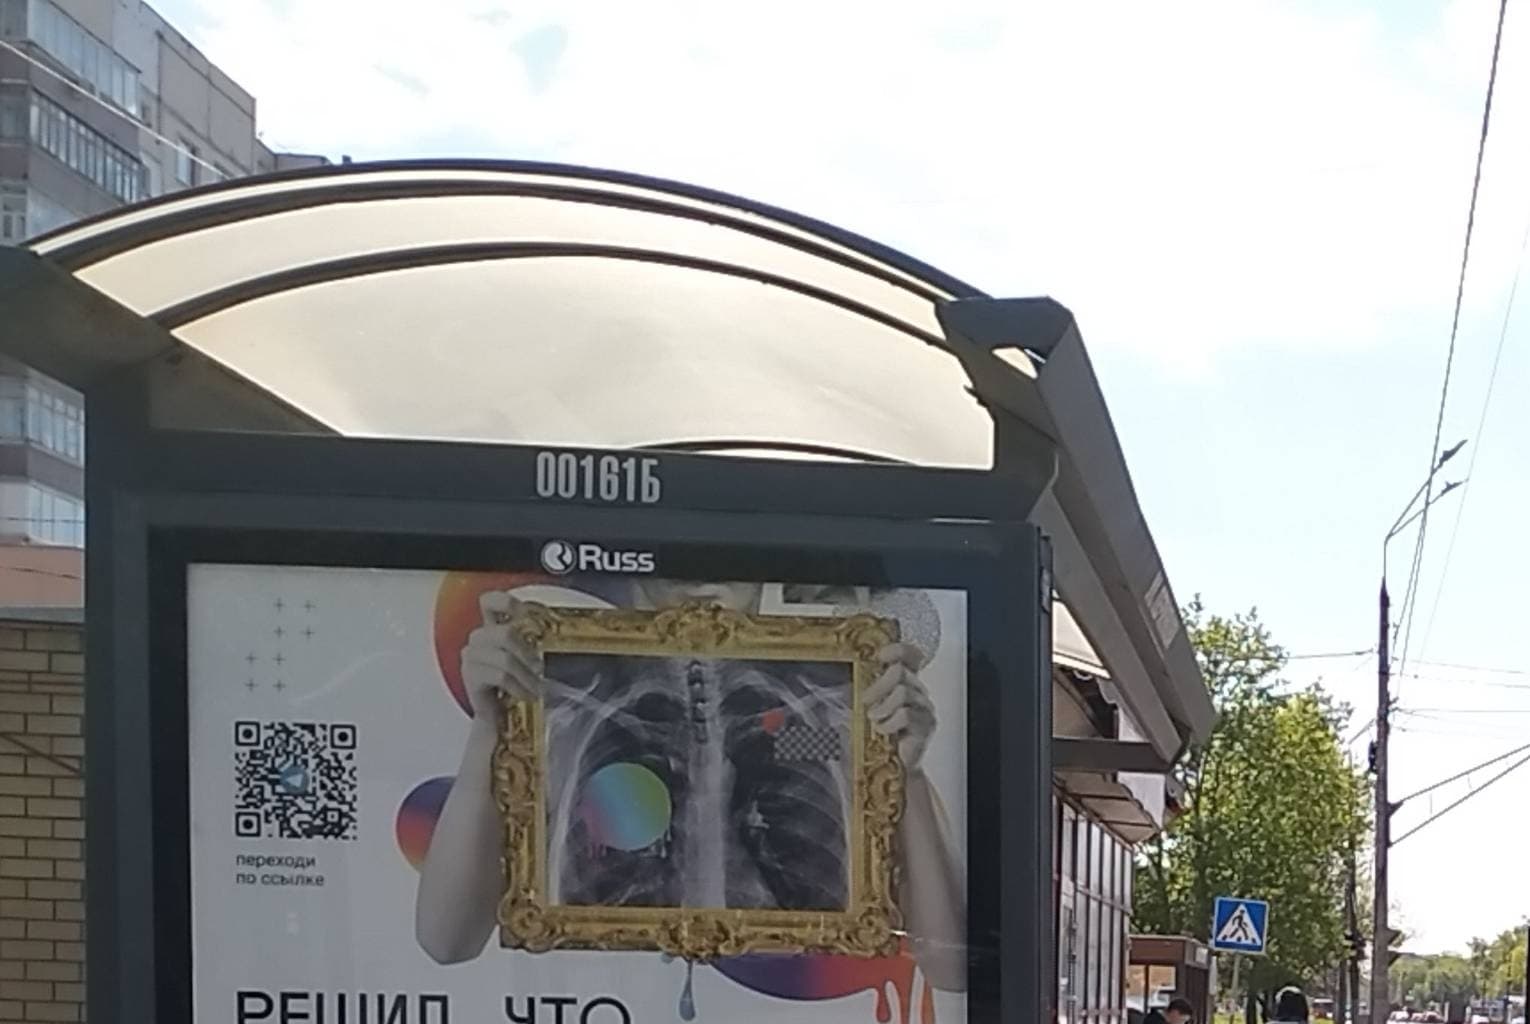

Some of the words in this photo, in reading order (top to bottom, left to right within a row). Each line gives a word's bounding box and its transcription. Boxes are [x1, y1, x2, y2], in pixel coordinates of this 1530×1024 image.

[536, 452, 661, 504] 00161Б
[578, 543, 655, 573] Russ
[235, 854, 316, 869] переходи
[235, 873, 257, 885] по
[261, 873, 325, 886] ссылке
